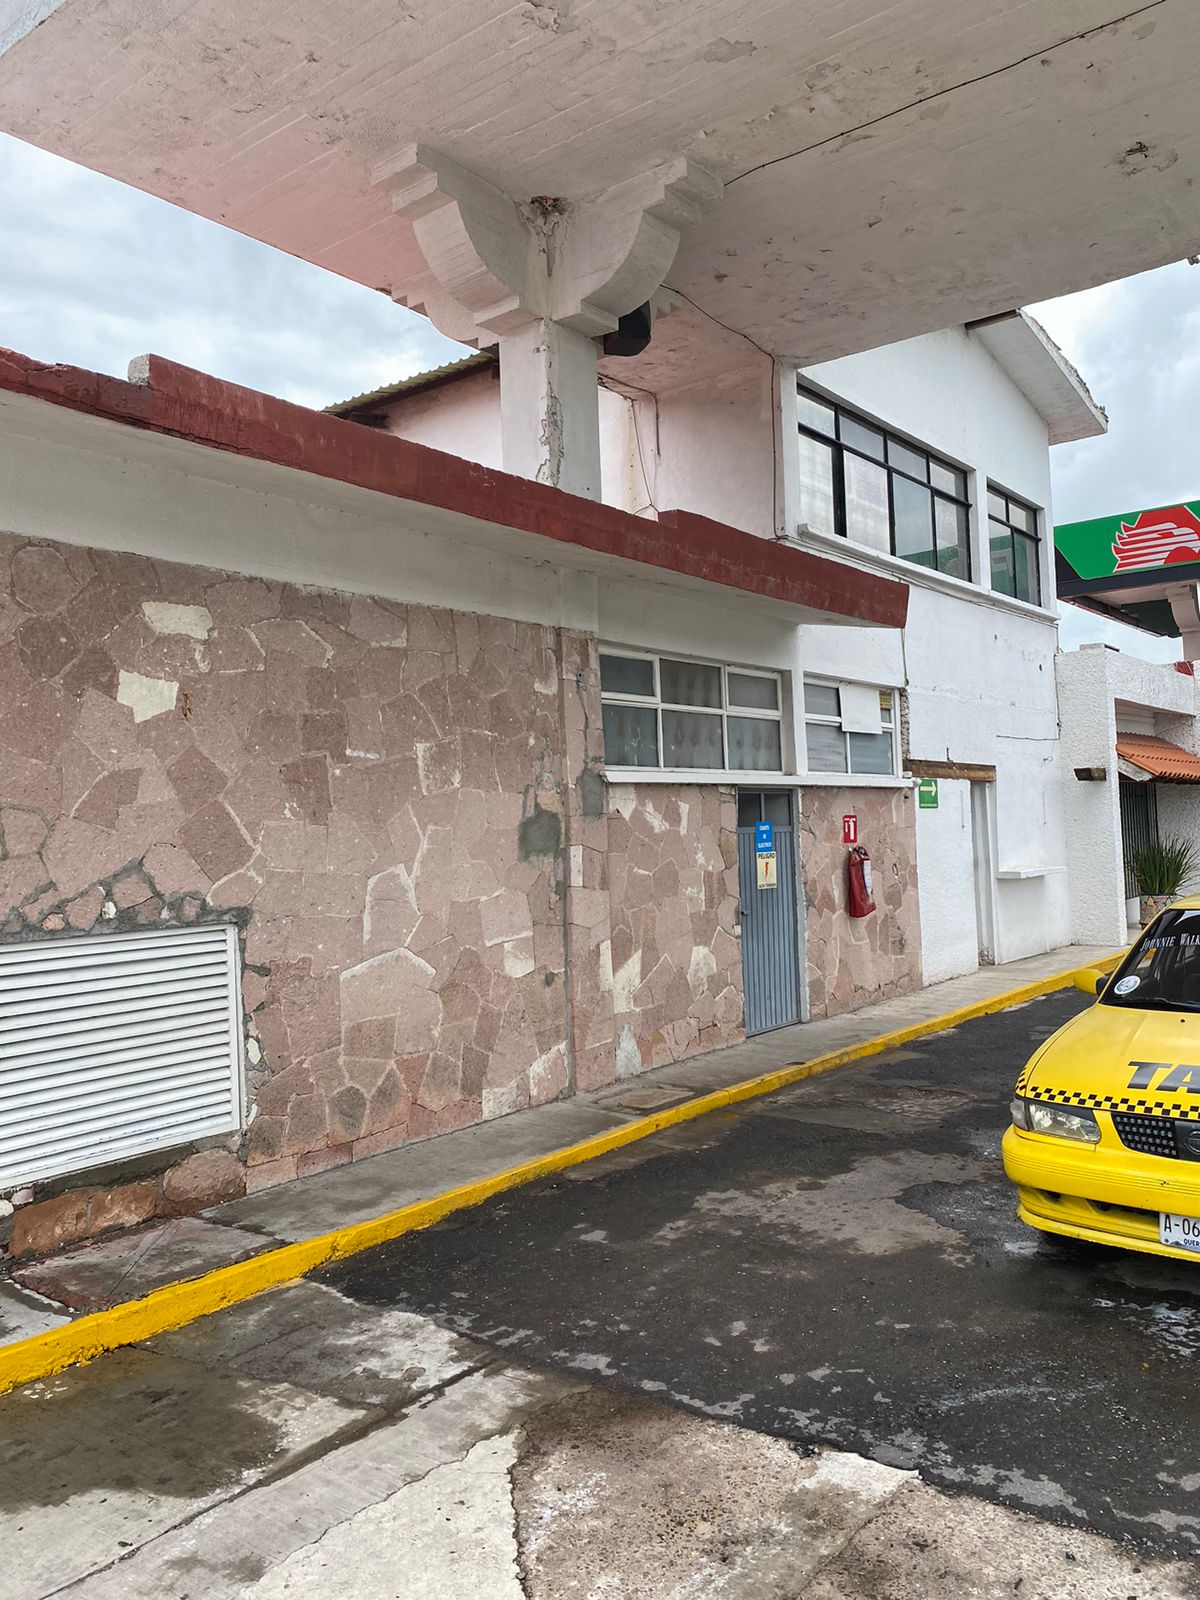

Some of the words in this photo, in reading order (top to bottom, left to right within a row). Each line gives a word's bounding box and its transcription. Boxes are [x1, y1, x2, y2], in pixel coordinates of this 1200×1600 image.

[1140, 935, 1176, 952] JOHNNIE
[1127, 1061, 1200, 1094] TA
[1164, 1214, 1200, 1237] A-06
[1183, 1238, 1200, 1246] QUER
